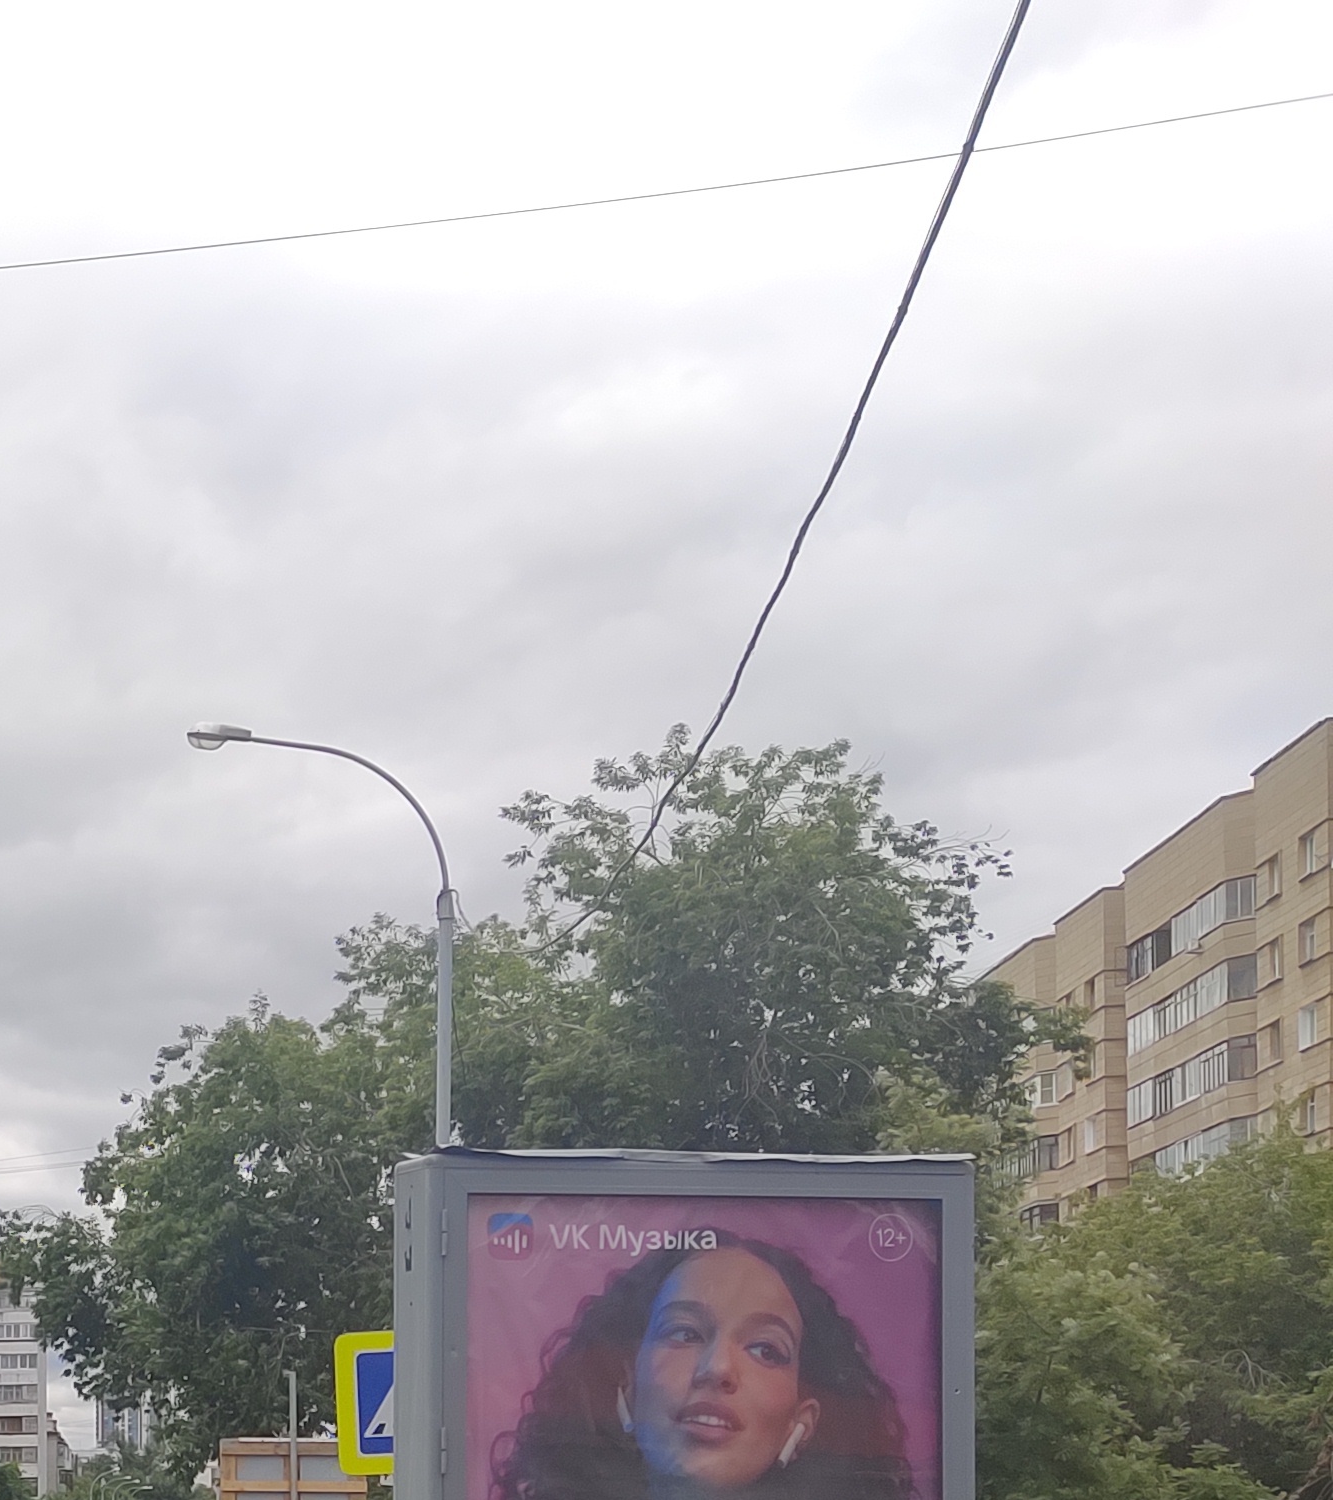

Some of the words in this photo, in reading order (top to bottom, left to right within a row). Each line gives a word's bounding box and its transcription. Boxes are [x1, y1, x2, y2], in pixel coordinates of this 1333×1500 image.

[548, 1224, 591, 1250] VK
[598, 1224, 718, 1257] Музыка
[875, 1227, 908, 1248] 12+
